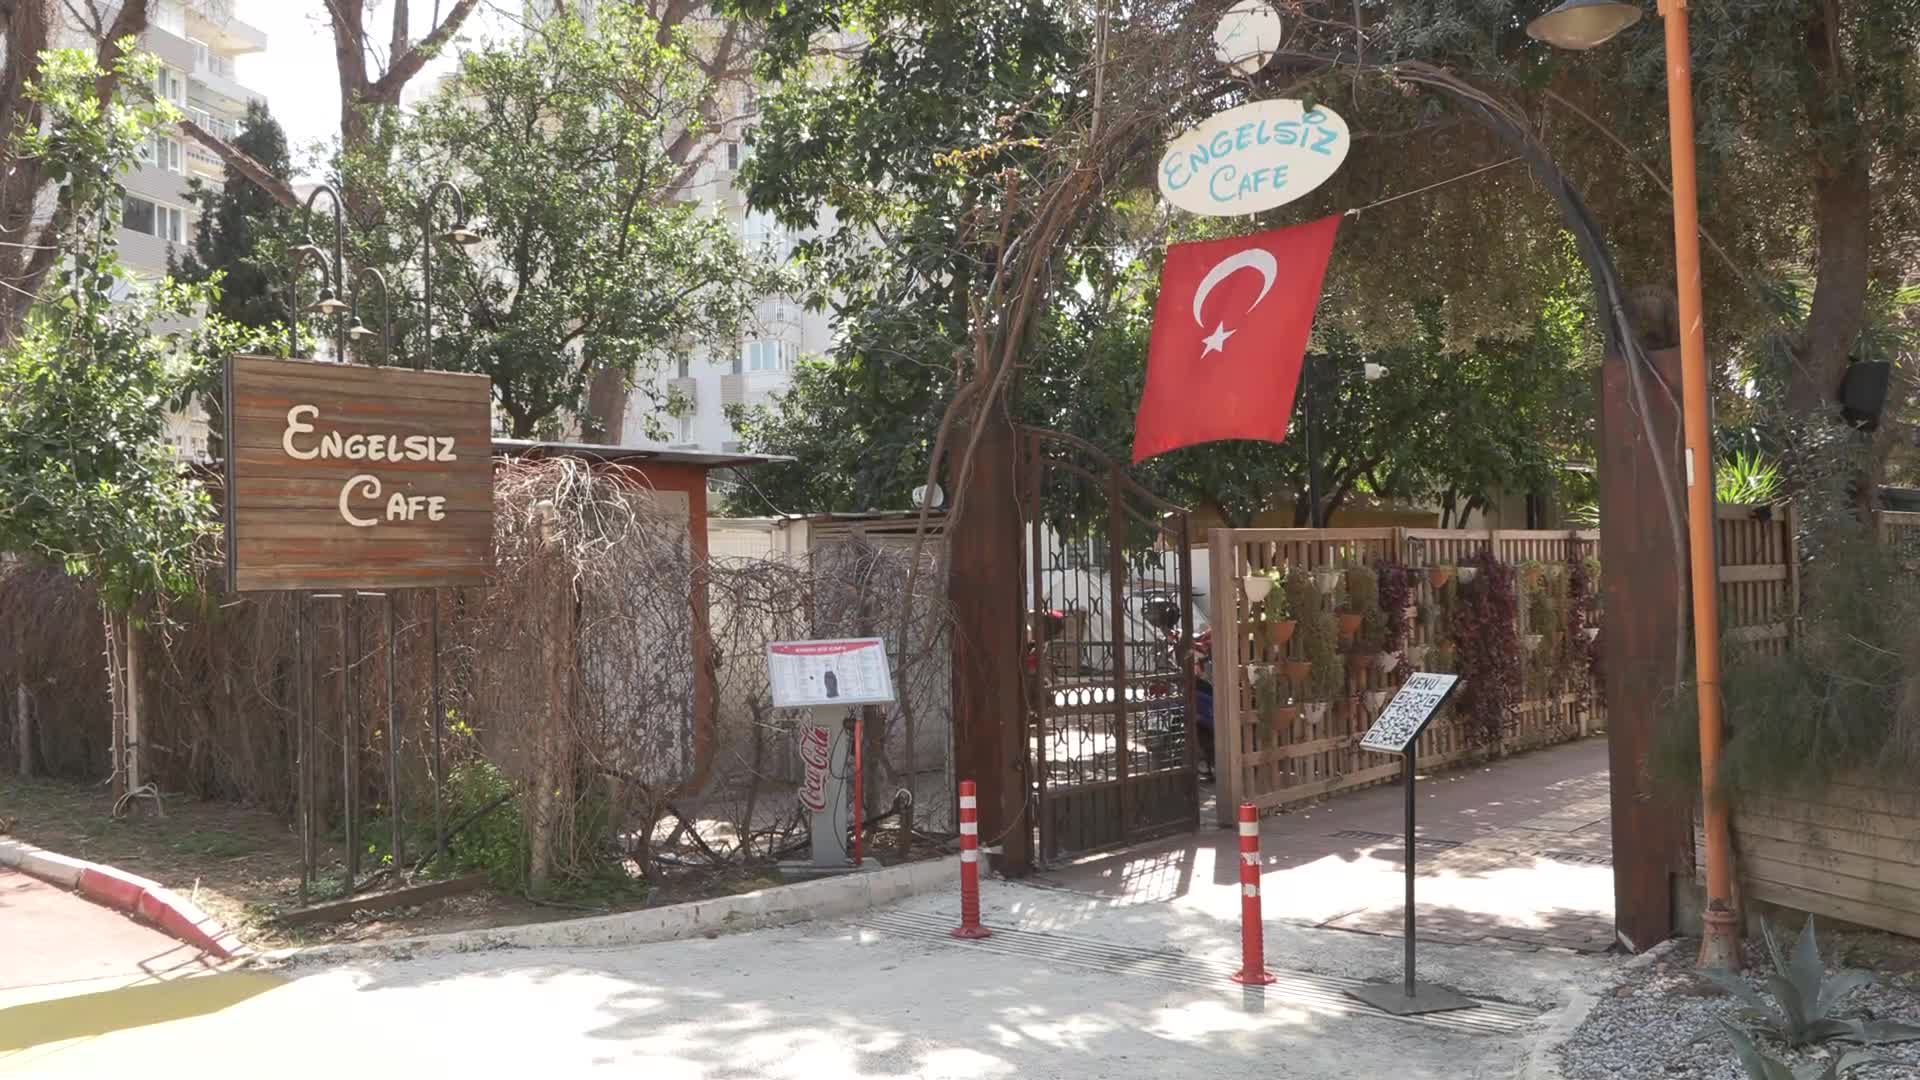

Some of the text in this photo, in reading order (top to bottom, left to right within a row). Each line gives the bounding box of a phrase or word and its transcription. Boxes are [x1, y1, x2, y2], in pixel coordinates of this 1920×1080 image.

[1209, 164, 1289, 203] CAFE
[282, 404, 457, 462] ENGELSIZ
[339, 474, 446, 527] CAFE
